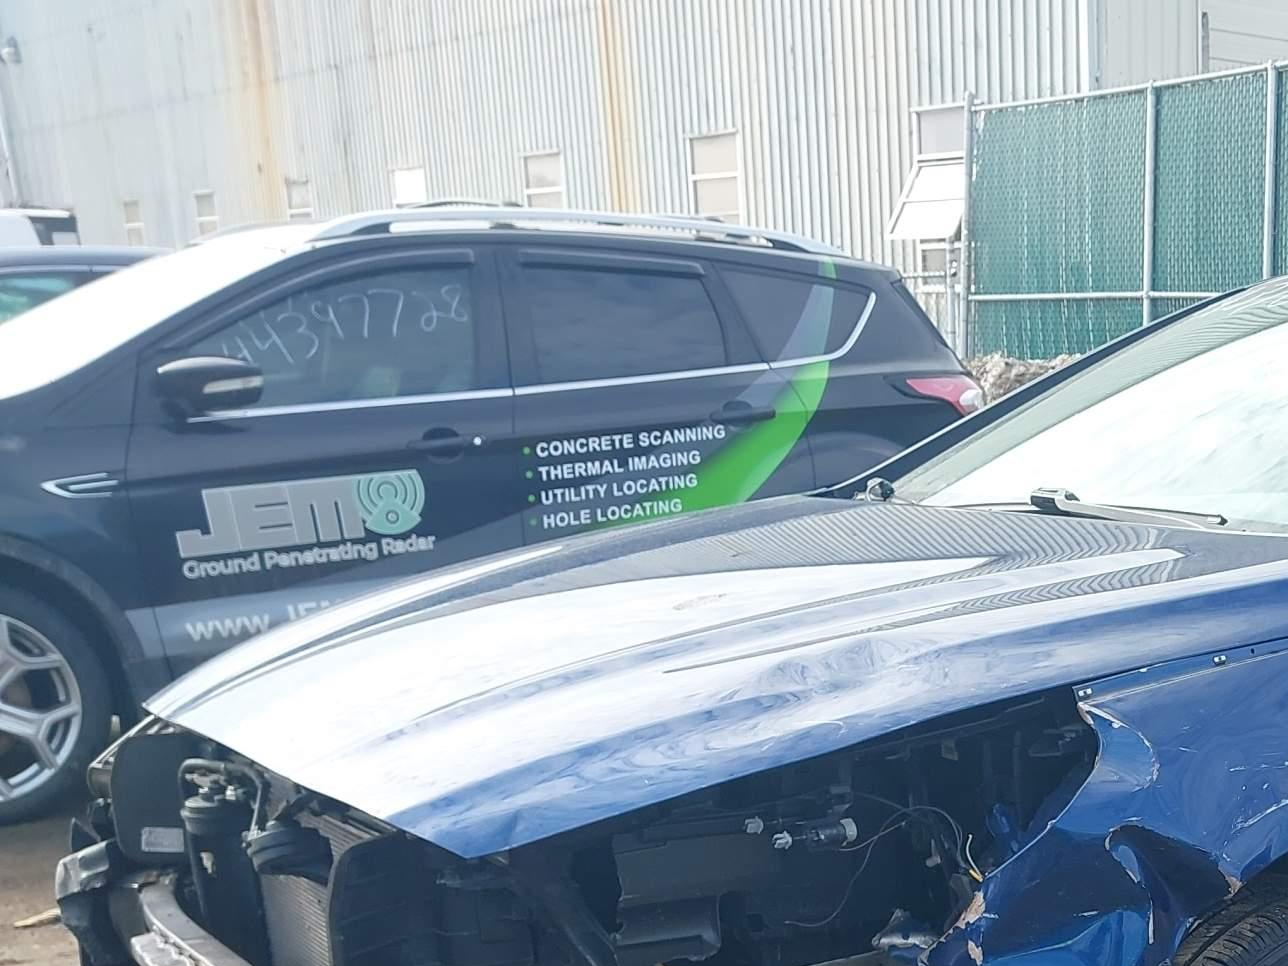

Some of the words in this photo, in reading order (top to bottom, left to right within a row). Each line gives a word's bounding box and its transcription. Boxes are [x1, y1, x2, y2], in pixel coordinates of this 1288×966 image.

[536, 433, 635, 458] CONCRETE
[638, 424, 726, 448] SCANNING
[537, 459, 625, 482] THERMAL
[628, 450, 702, 472] IMAGING
[540, 483, 608, 506] UTILITY
[613, 473, 699, 496] LOCATING
[176, 475, 366, 559] JEM
[543, 508, 592, 530] HOLE
[596, 498, 683, 522] LOCATING
[182, 552, 262, 580] Ground
[264, 541, 379, 571] Penetrating
[381, 534, 437, 556] Radar
